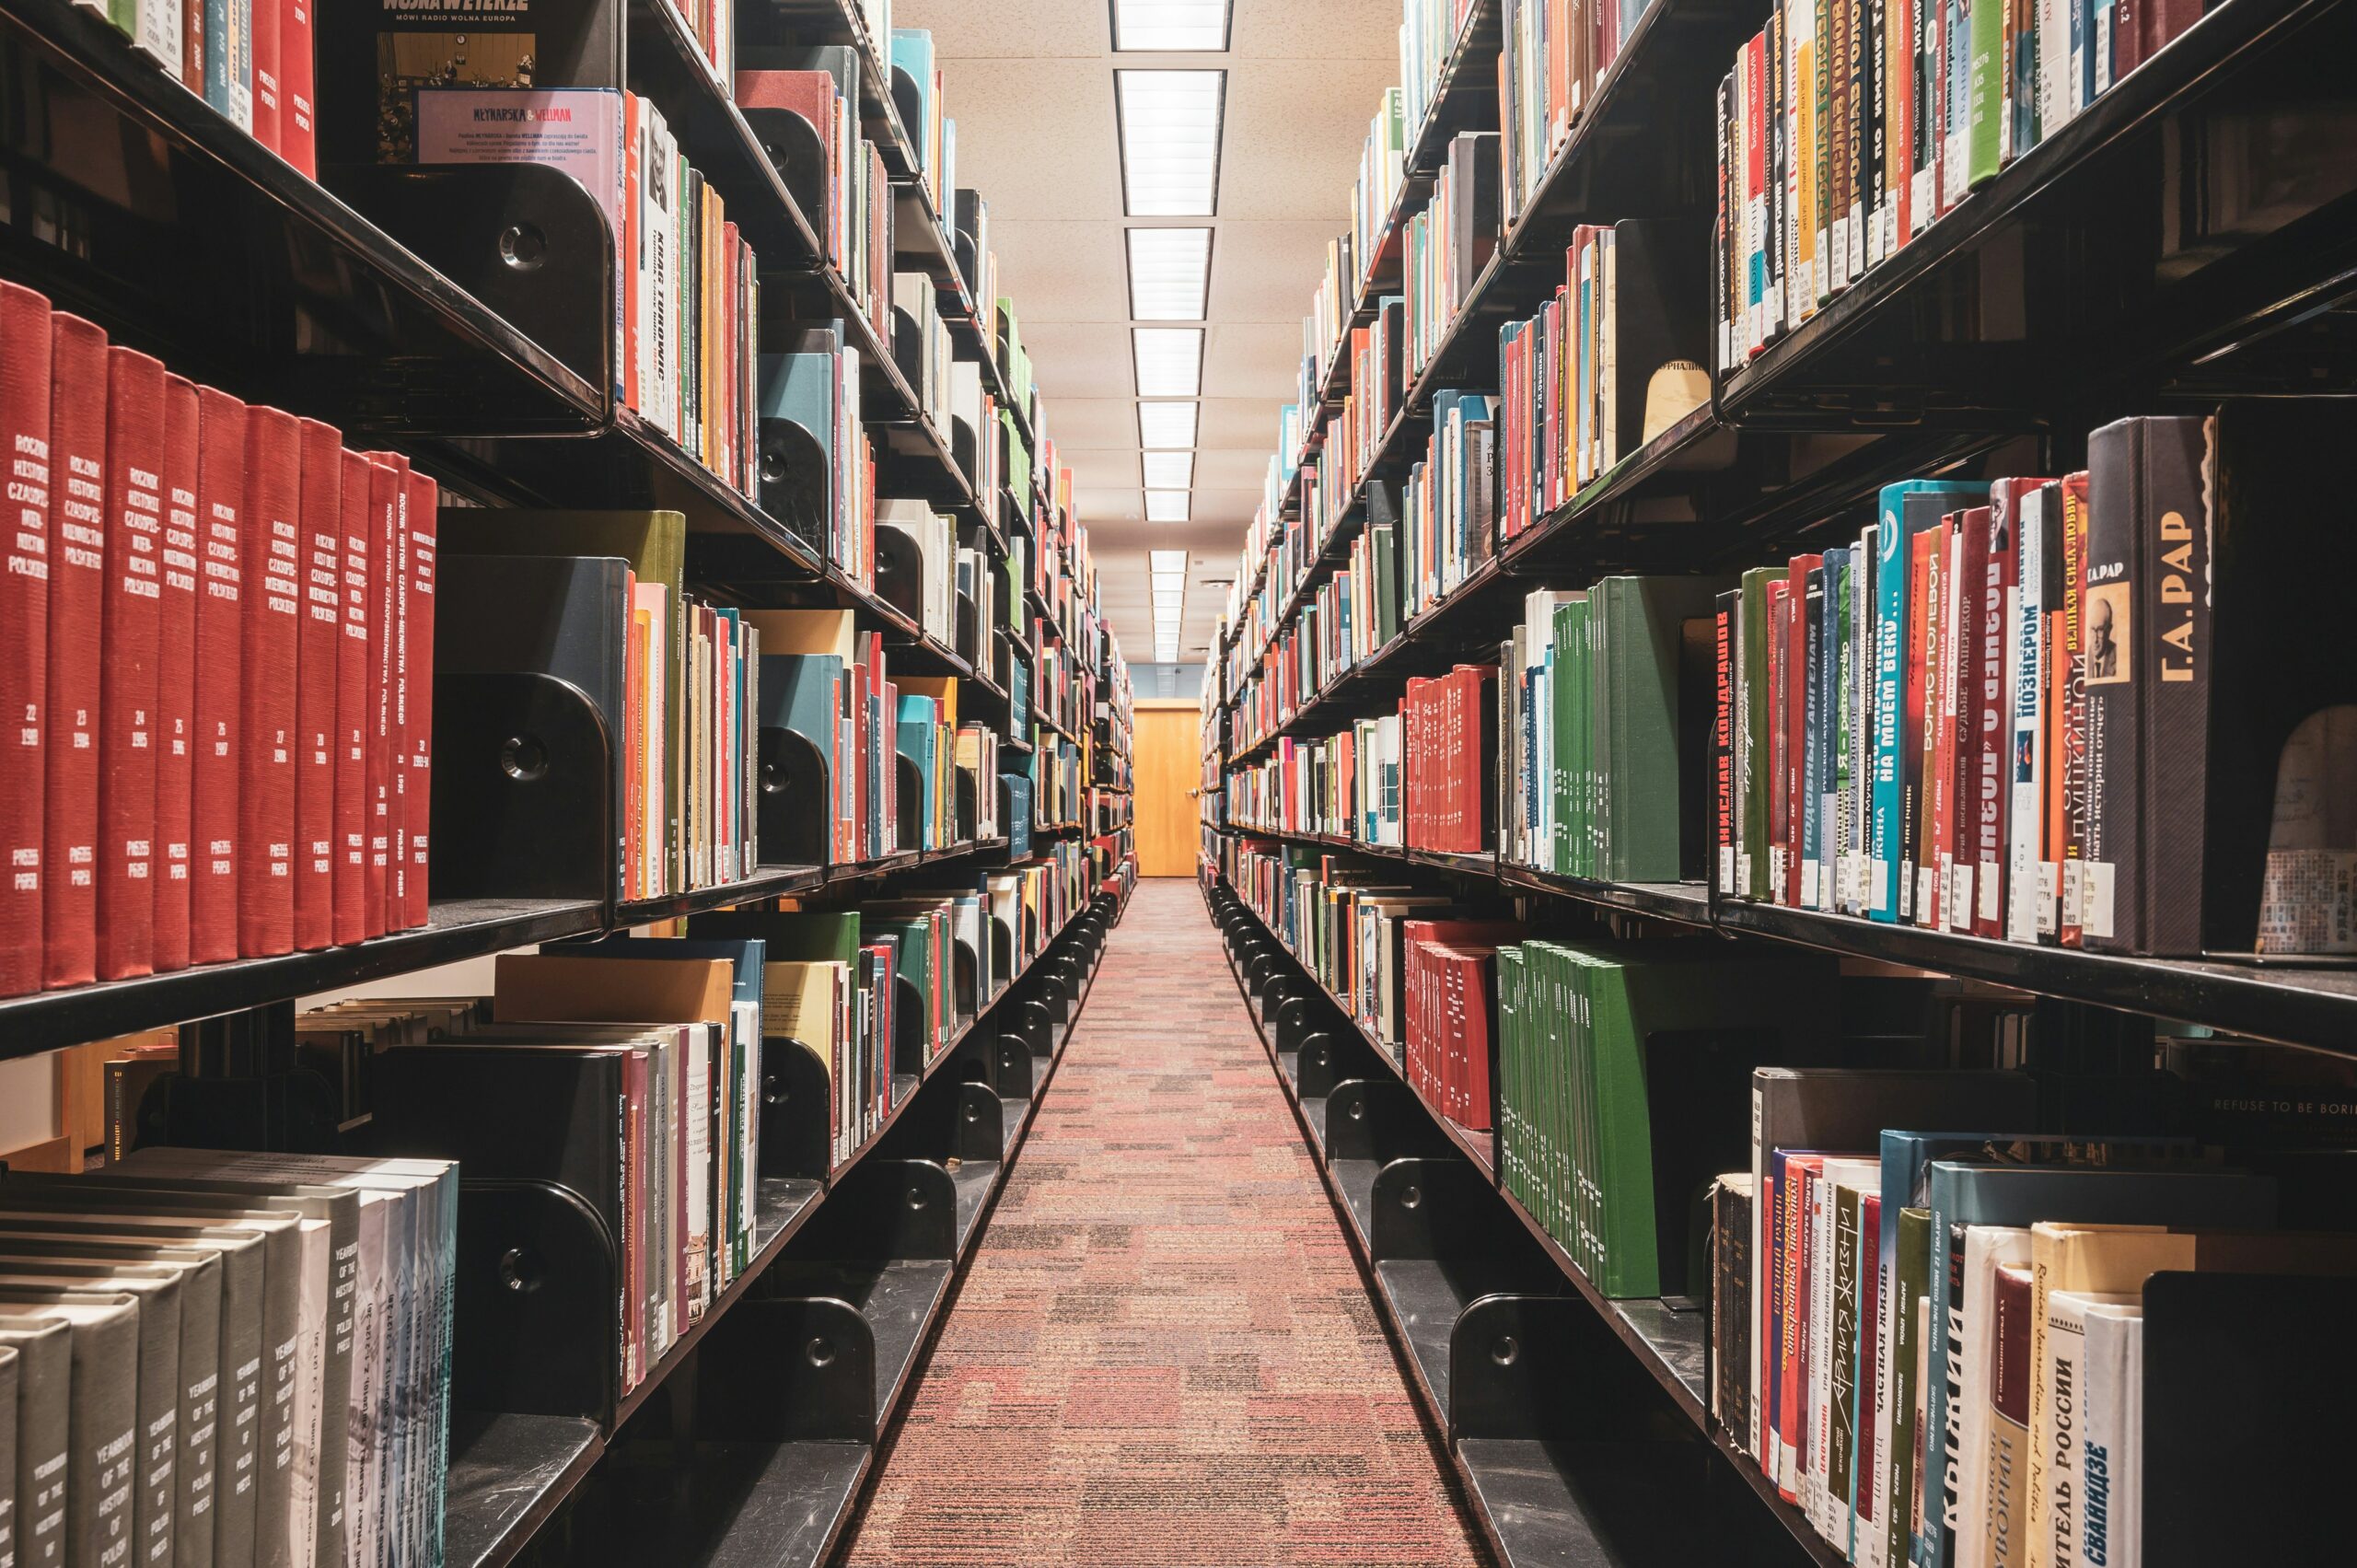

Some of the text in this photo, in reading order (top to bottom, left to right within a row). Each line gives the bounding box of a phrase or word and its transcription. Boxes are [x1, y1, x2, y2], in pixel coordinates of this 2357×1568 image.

[396, 14, 419, 22] MÓWI
[422, 14, 447, 22] RADIO
[1774, 9, 1782, 103] МИКРОФОНА
[1945, 20, 1955, 77] Юркова
[473, 108, 526, 122] MŁYNARSKA
[535, 108, 572, 122] WELLMAN
[1789, 37, 1798, 194] Пульс Тушина
[1873, 33, 1883, 159] по имени
[1831, 96, 1847, 219] ЯРОСЛАВ
[1774, 181, 1784, 274] ДЫМАРСКИЙ
[397, 575, 406, 674] CZASOPIS-MIENNICTWA
[2065, 494, 2078, 651] ВЕЛИКАЯ СИЛА ЛЮБВИ
[2160, 510, 2194, 682] Г.А.РАР
[1881, 590, 1898, 783] НА МОЕМ ВЕКУ...
[1923, 553, 1939, 752] БОРИС ПОЛЕВОЙ
[1946, 635, 1957, 711] Anna è viva
[1959, 594, 1972, 679] НАПЕРЕКОР.
[1984, 562, 2001, 701] ПОЗНЕР
[2022, 605, 2038, 718] ПОЗНЕРОМ
[1716, 611, 1730, 848] АНИСЛАВ КОНДРАШОВ
[1805, 622, 1817, 851] ПОДОБНЫЕ АНГЕЛАМ
[1957, 686, 1970, 743] СУДЬБЕ
[1984, 708, 1999, 732] О
[2062, 683, 2073, 811] ОКСАНЫ
[2069, 654, 2085, 838] ПУШКИНОЙ
[1864, 753, 1872, 813] Мукусев
[1864, 815, 1873, 856] димир
[1904, 784, 1912, 844] ПАСІЧНИК
[1934, 779, 1943, 812] PN5277
[2084, 696, 2096, 863] удет наше поколенье
[2093, 696, 2105, 862] авать истории отчет»
[1958, 832, 1967, 861] ЮРИЙ
[2213, 1098, 2266, 1112] REFUSE
[2272, 1101, 2291, 1113] TO
[2297, 1102, 2313, 1113] BE
[1773, 1246, 1782, 1315] ЕВГЕНИЙ
[1787, 1176, 1799, 1356] открытым текстом
[1825, 1182, 1833, 1274] ЖУРНАЛИСТИКИ
[1933, 1256, 1940, 1266] IZ
[1832, 1206, 1858, 1435] АРМИЯ ЖИЗНИ
[1931, 1304, 1939, 1353] DNEVNIKA
[1873, 1262, 1888, 1499] ШВАРЦ ЧАСТНАЯ ЖИЗНЬ
[2030, 1262, 2049, 1524] Russian Journalism and Politics
[2055, 1356, 2073, 1471] РОССИИ
[2085, 1440, 2109, 1568] СВАНИДЗЕ
